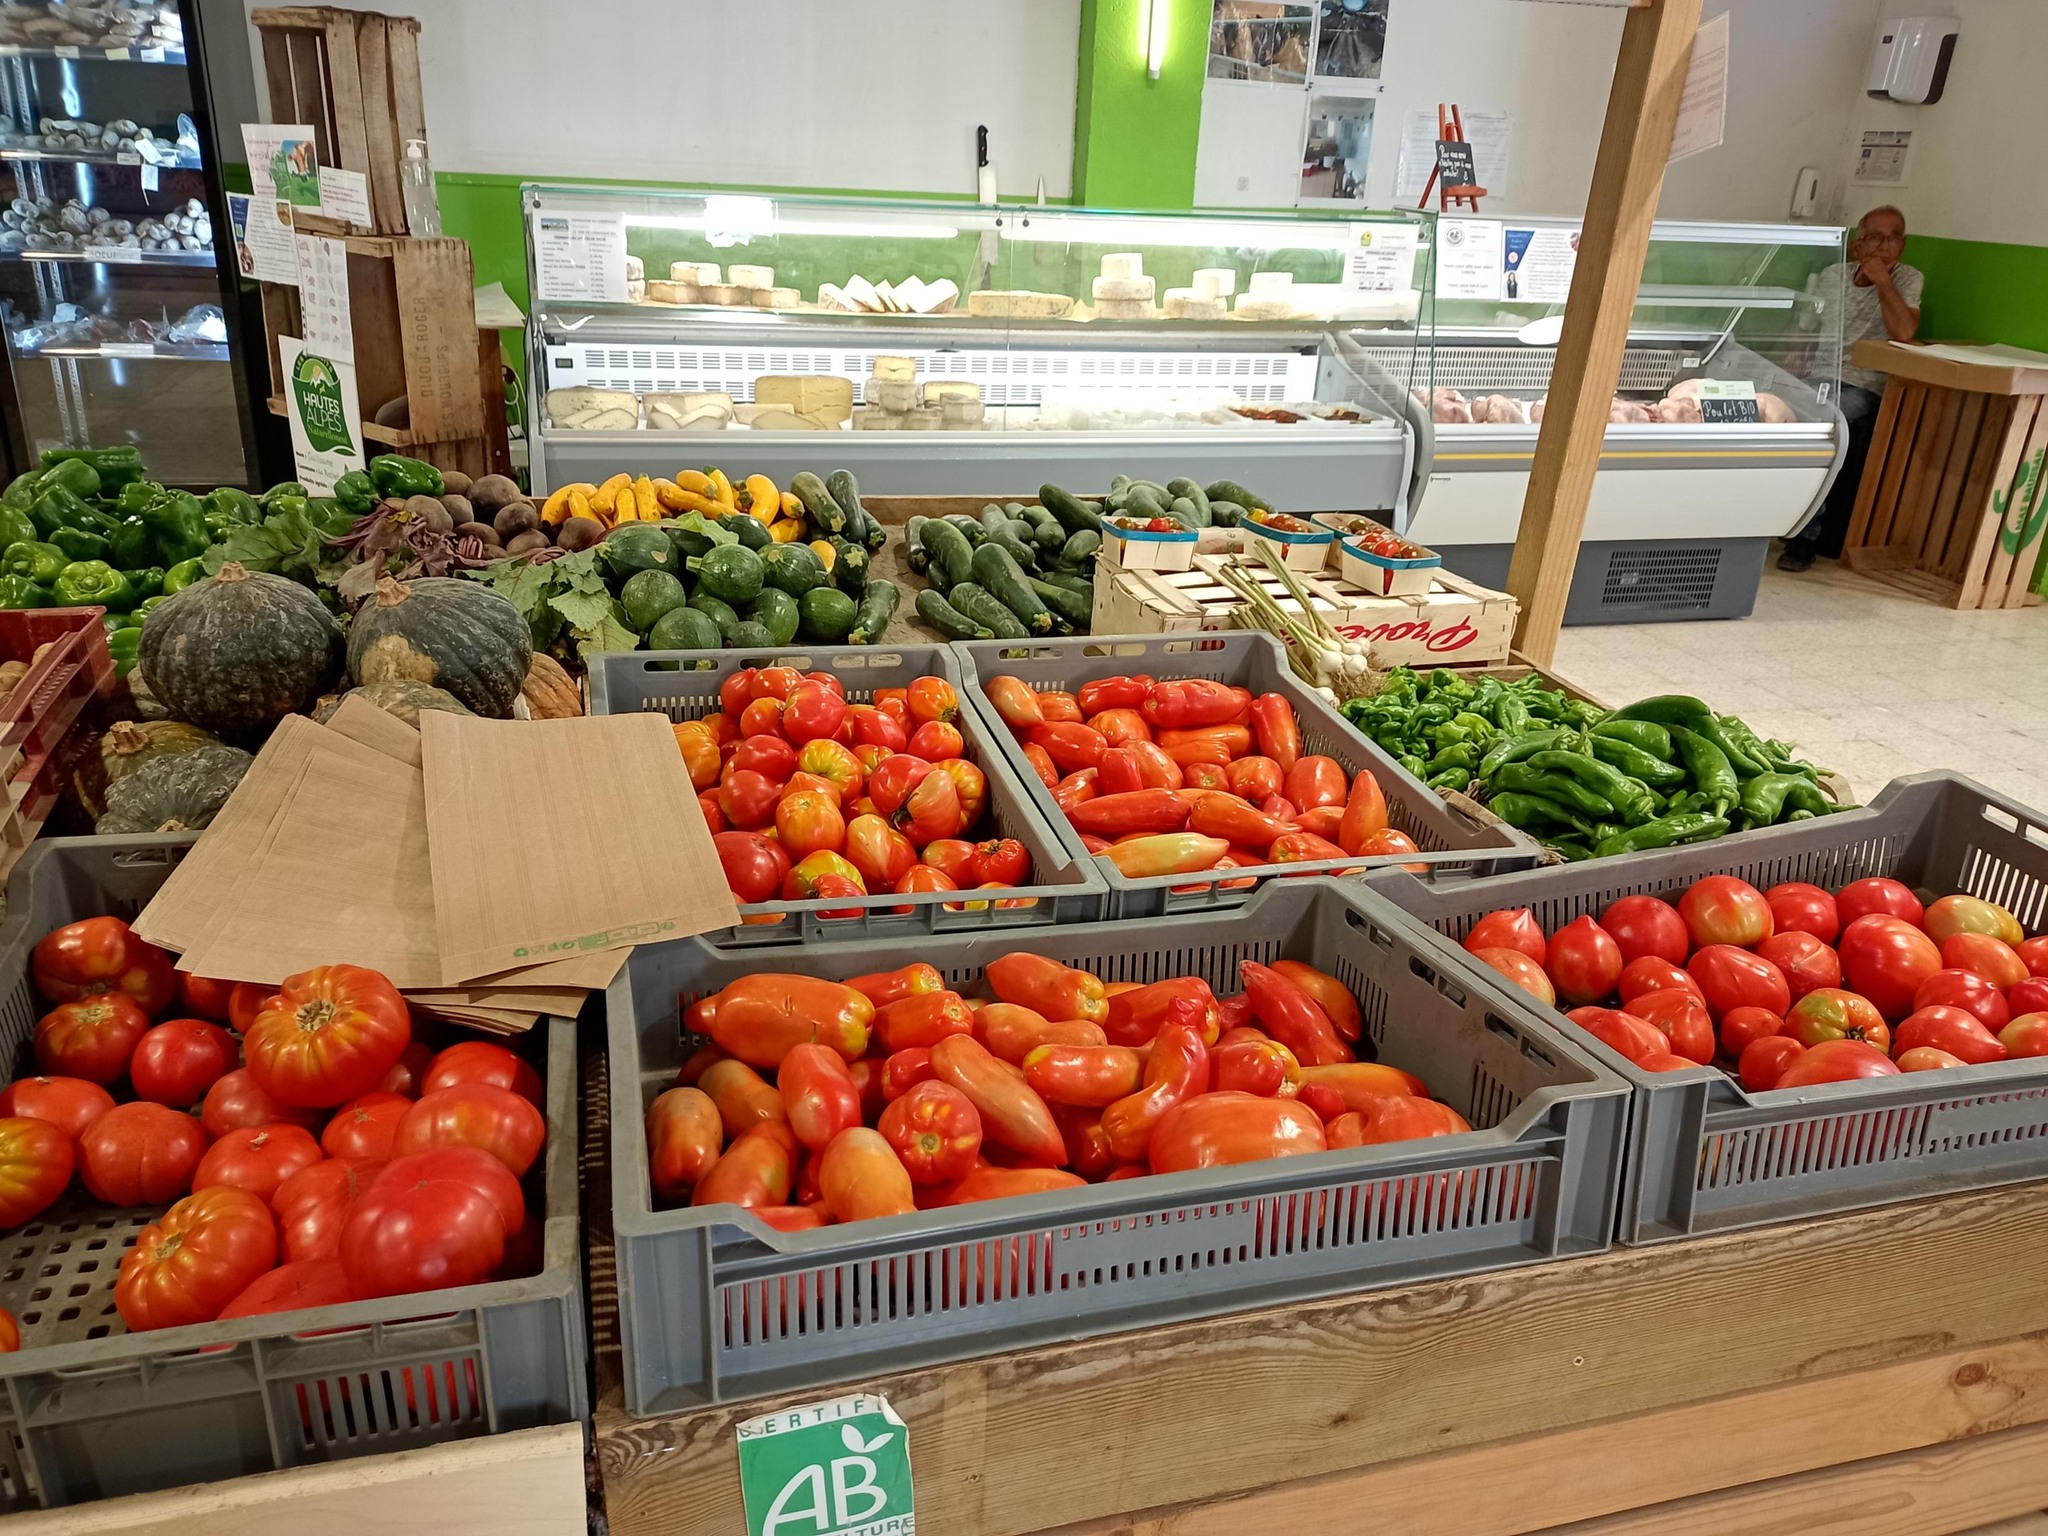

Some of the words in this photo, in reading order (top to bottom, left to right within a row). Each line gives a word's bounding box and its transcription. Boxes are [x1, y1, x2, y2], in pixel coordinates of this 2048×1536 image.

[303, 391, 340, 414] HAUTES
[1703, 400, 1738, 417] Poulet
[306, 407, 342, 433] ALPES
[1334, 615, 1479, 653] Prove
[739, 1400, 882, 1438] CERTIF
[762, 1456, 887, 1536] AB
